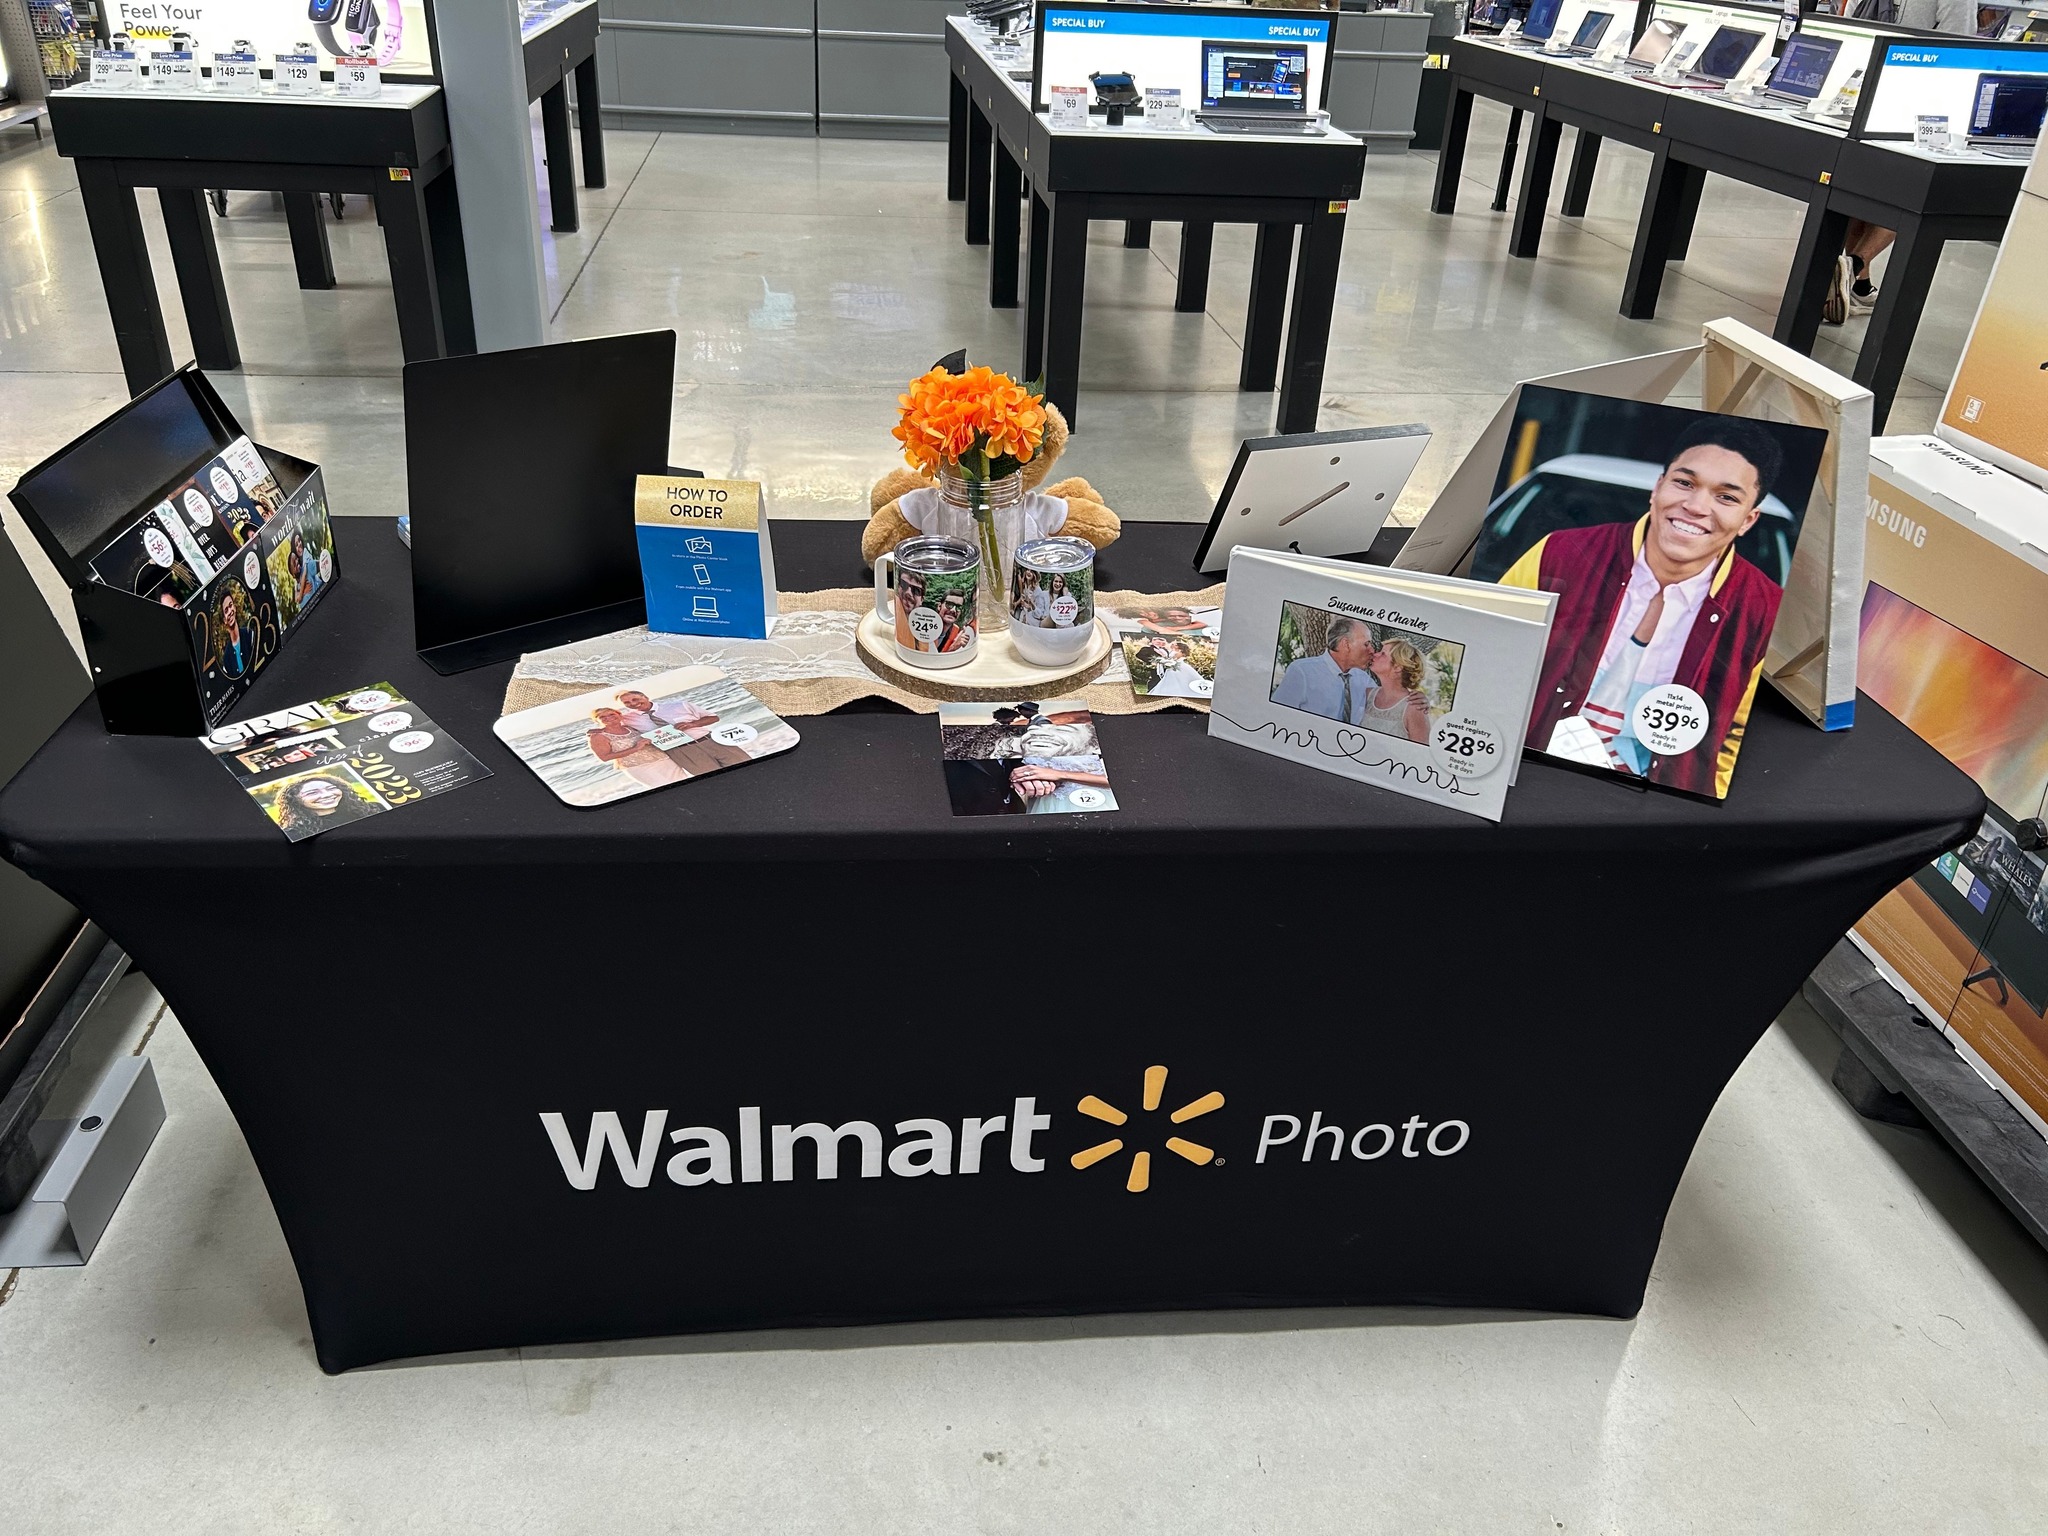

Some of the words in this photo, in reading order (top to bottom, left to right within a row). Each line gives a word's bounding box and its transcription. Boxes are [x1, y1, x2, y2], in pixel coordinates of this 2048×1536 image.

[120, 4, 156, 18] Feel
[161, 4, 202, 20] Your
[124, 21, 180, 36] Power
[1052, 17, 1085, 29] SPECIAL
[1087, 19, 1106, 29] BUY
[1268, 25, 1300, 36] SPECIAL
[1302, 27, 1320, 37] BUY
[1892, 53, 1921, 62] SPECIAL
[153, 65, 172, 75] $149
[217, 67, 234, 77] $149
[288, 69, 307, 79] $129
[350, 71, 365, 82] $59
[1064, 99, 1076, 108] $69
[1147, 101, 1162, 109] $229
[1920, 126, 1933, 135] $399
[1922, 442, 1993, 476] SAMSUNG
[667, 487, 704, 501] HOW
[708, 490, 728, 502] TO
[227, 507, 251, 523] 2023
[670, 504, 723, 519] ORDER
[271, 515, 293, 547] worth
[300, 491, 315, 514] wait
[1866, 495, 1927, 548] MSUNG
[1327, 596, 1375, 618] Susanna
[1377, 609, 1385, 619] &
[1387, 611, 1429, 631] Charles
[1667, 693, 1683, 702] 11x14
[209, 699, 222, 716] TYLER
[1656, 699, 1675, 707] metal
[1675, 702, 1692, 712] print
[1446, 722, 1464, 730] guest
[1466, 726, 1491, 737] registry
[1652, 731, 1670, 741] Ready
[1449, 757, 1467, 766] Ready
[348, 752, 422, 805] 2023
[2001, 854, 2032, 888] WHALES
[539, 1096, 1051, 1190] Walmart
[1254, 1112, 1471, 1164] Photo
